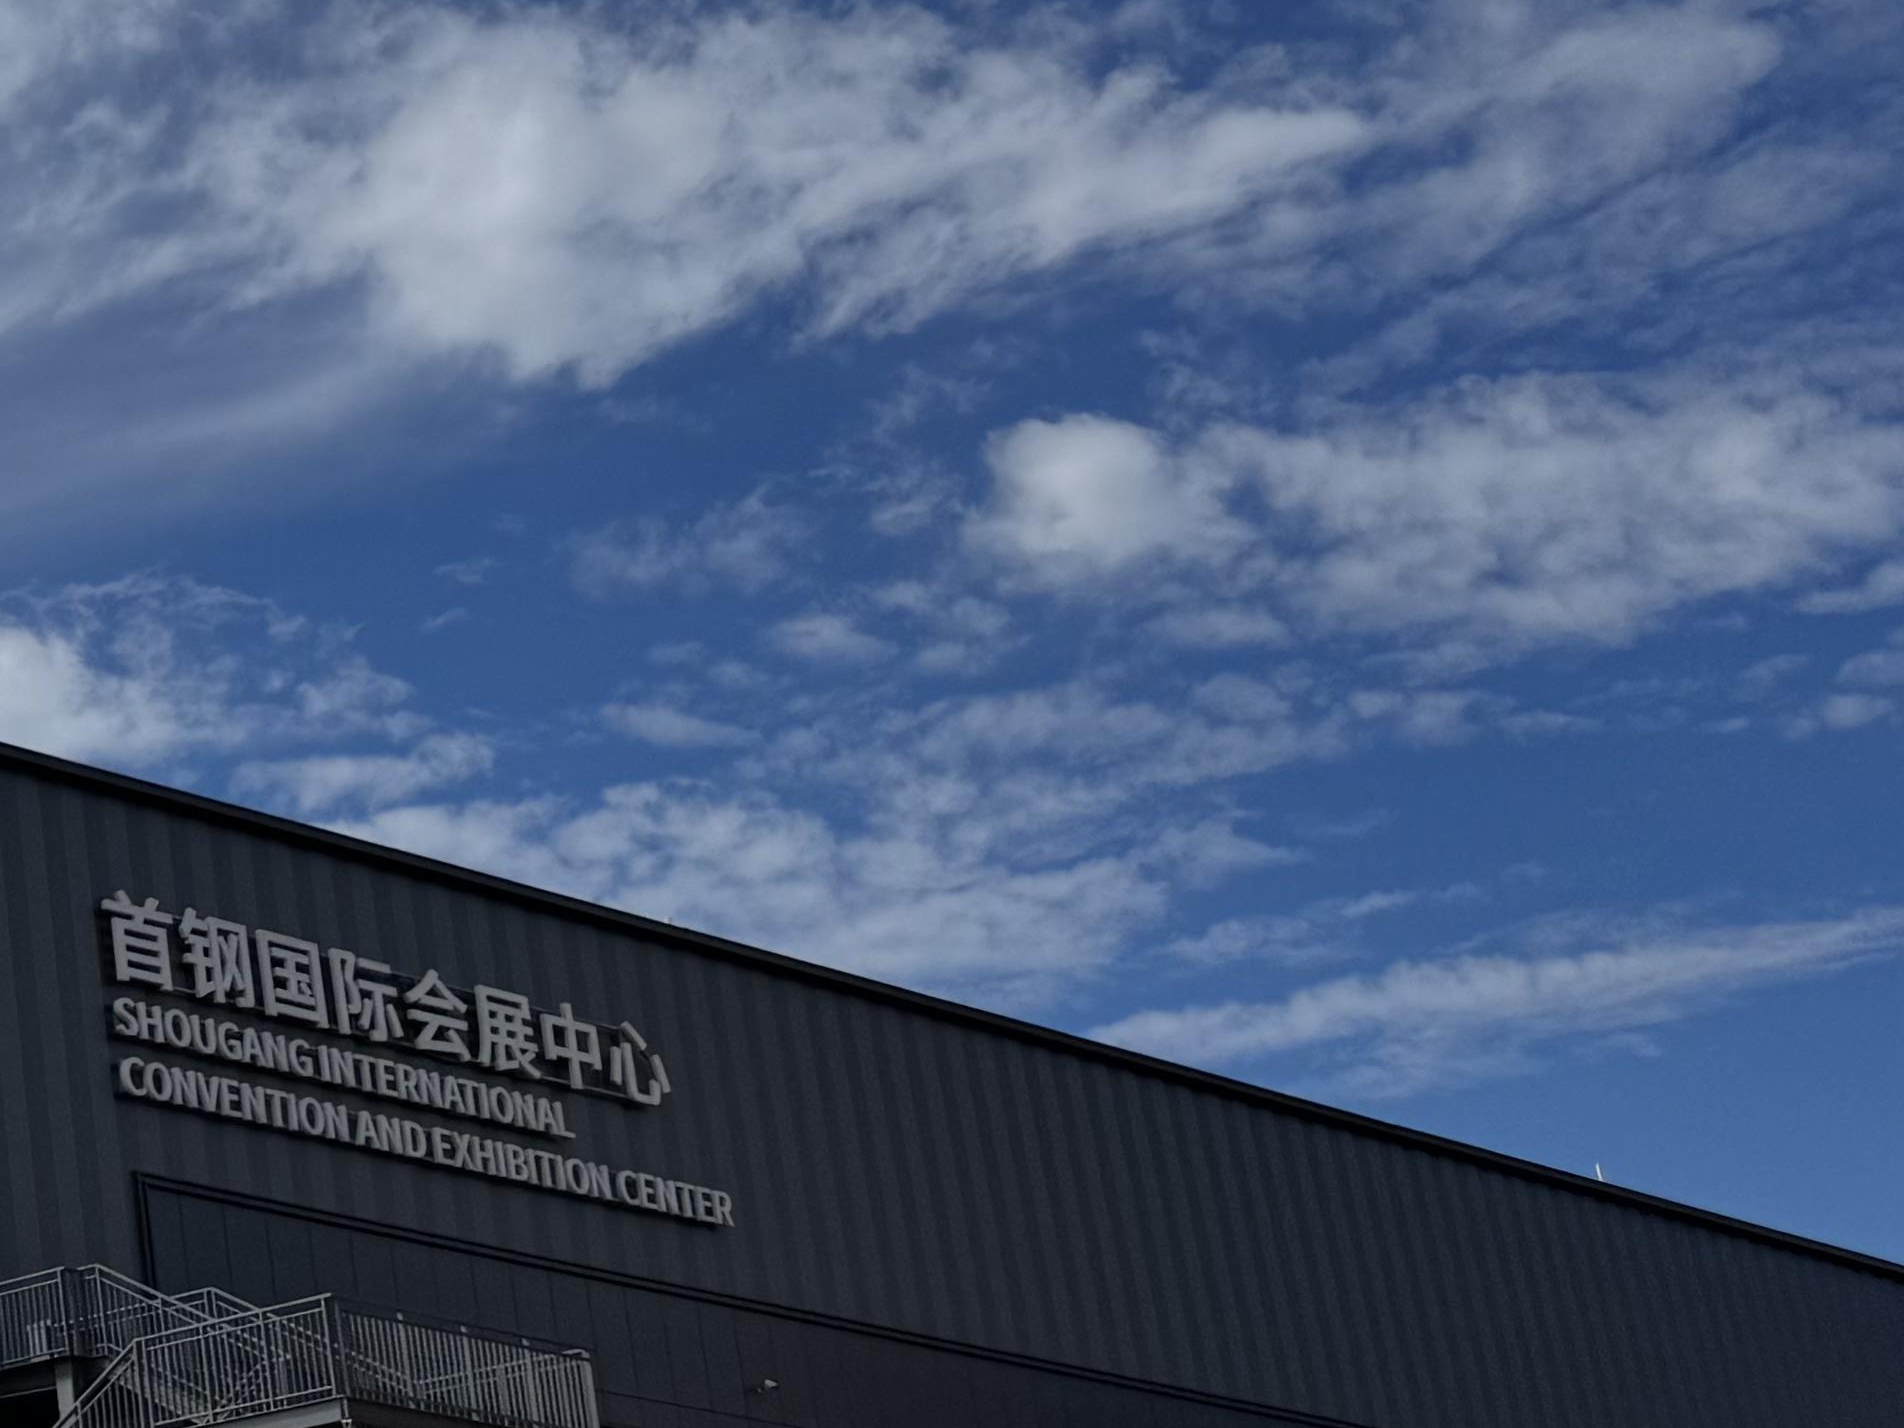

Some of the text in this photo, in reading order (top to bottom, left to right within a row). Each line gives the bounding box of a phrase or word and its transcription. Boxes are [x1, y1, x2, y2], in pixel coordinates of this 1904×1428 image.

[101, 889, 670, 1106] 首钢国际会展中心
[111, 996, 577, 1139] SHOUGANG INTERNATIONAL
[118, 1055, 735, 1227] CONVENTION AND EXHIBITION CENTER
